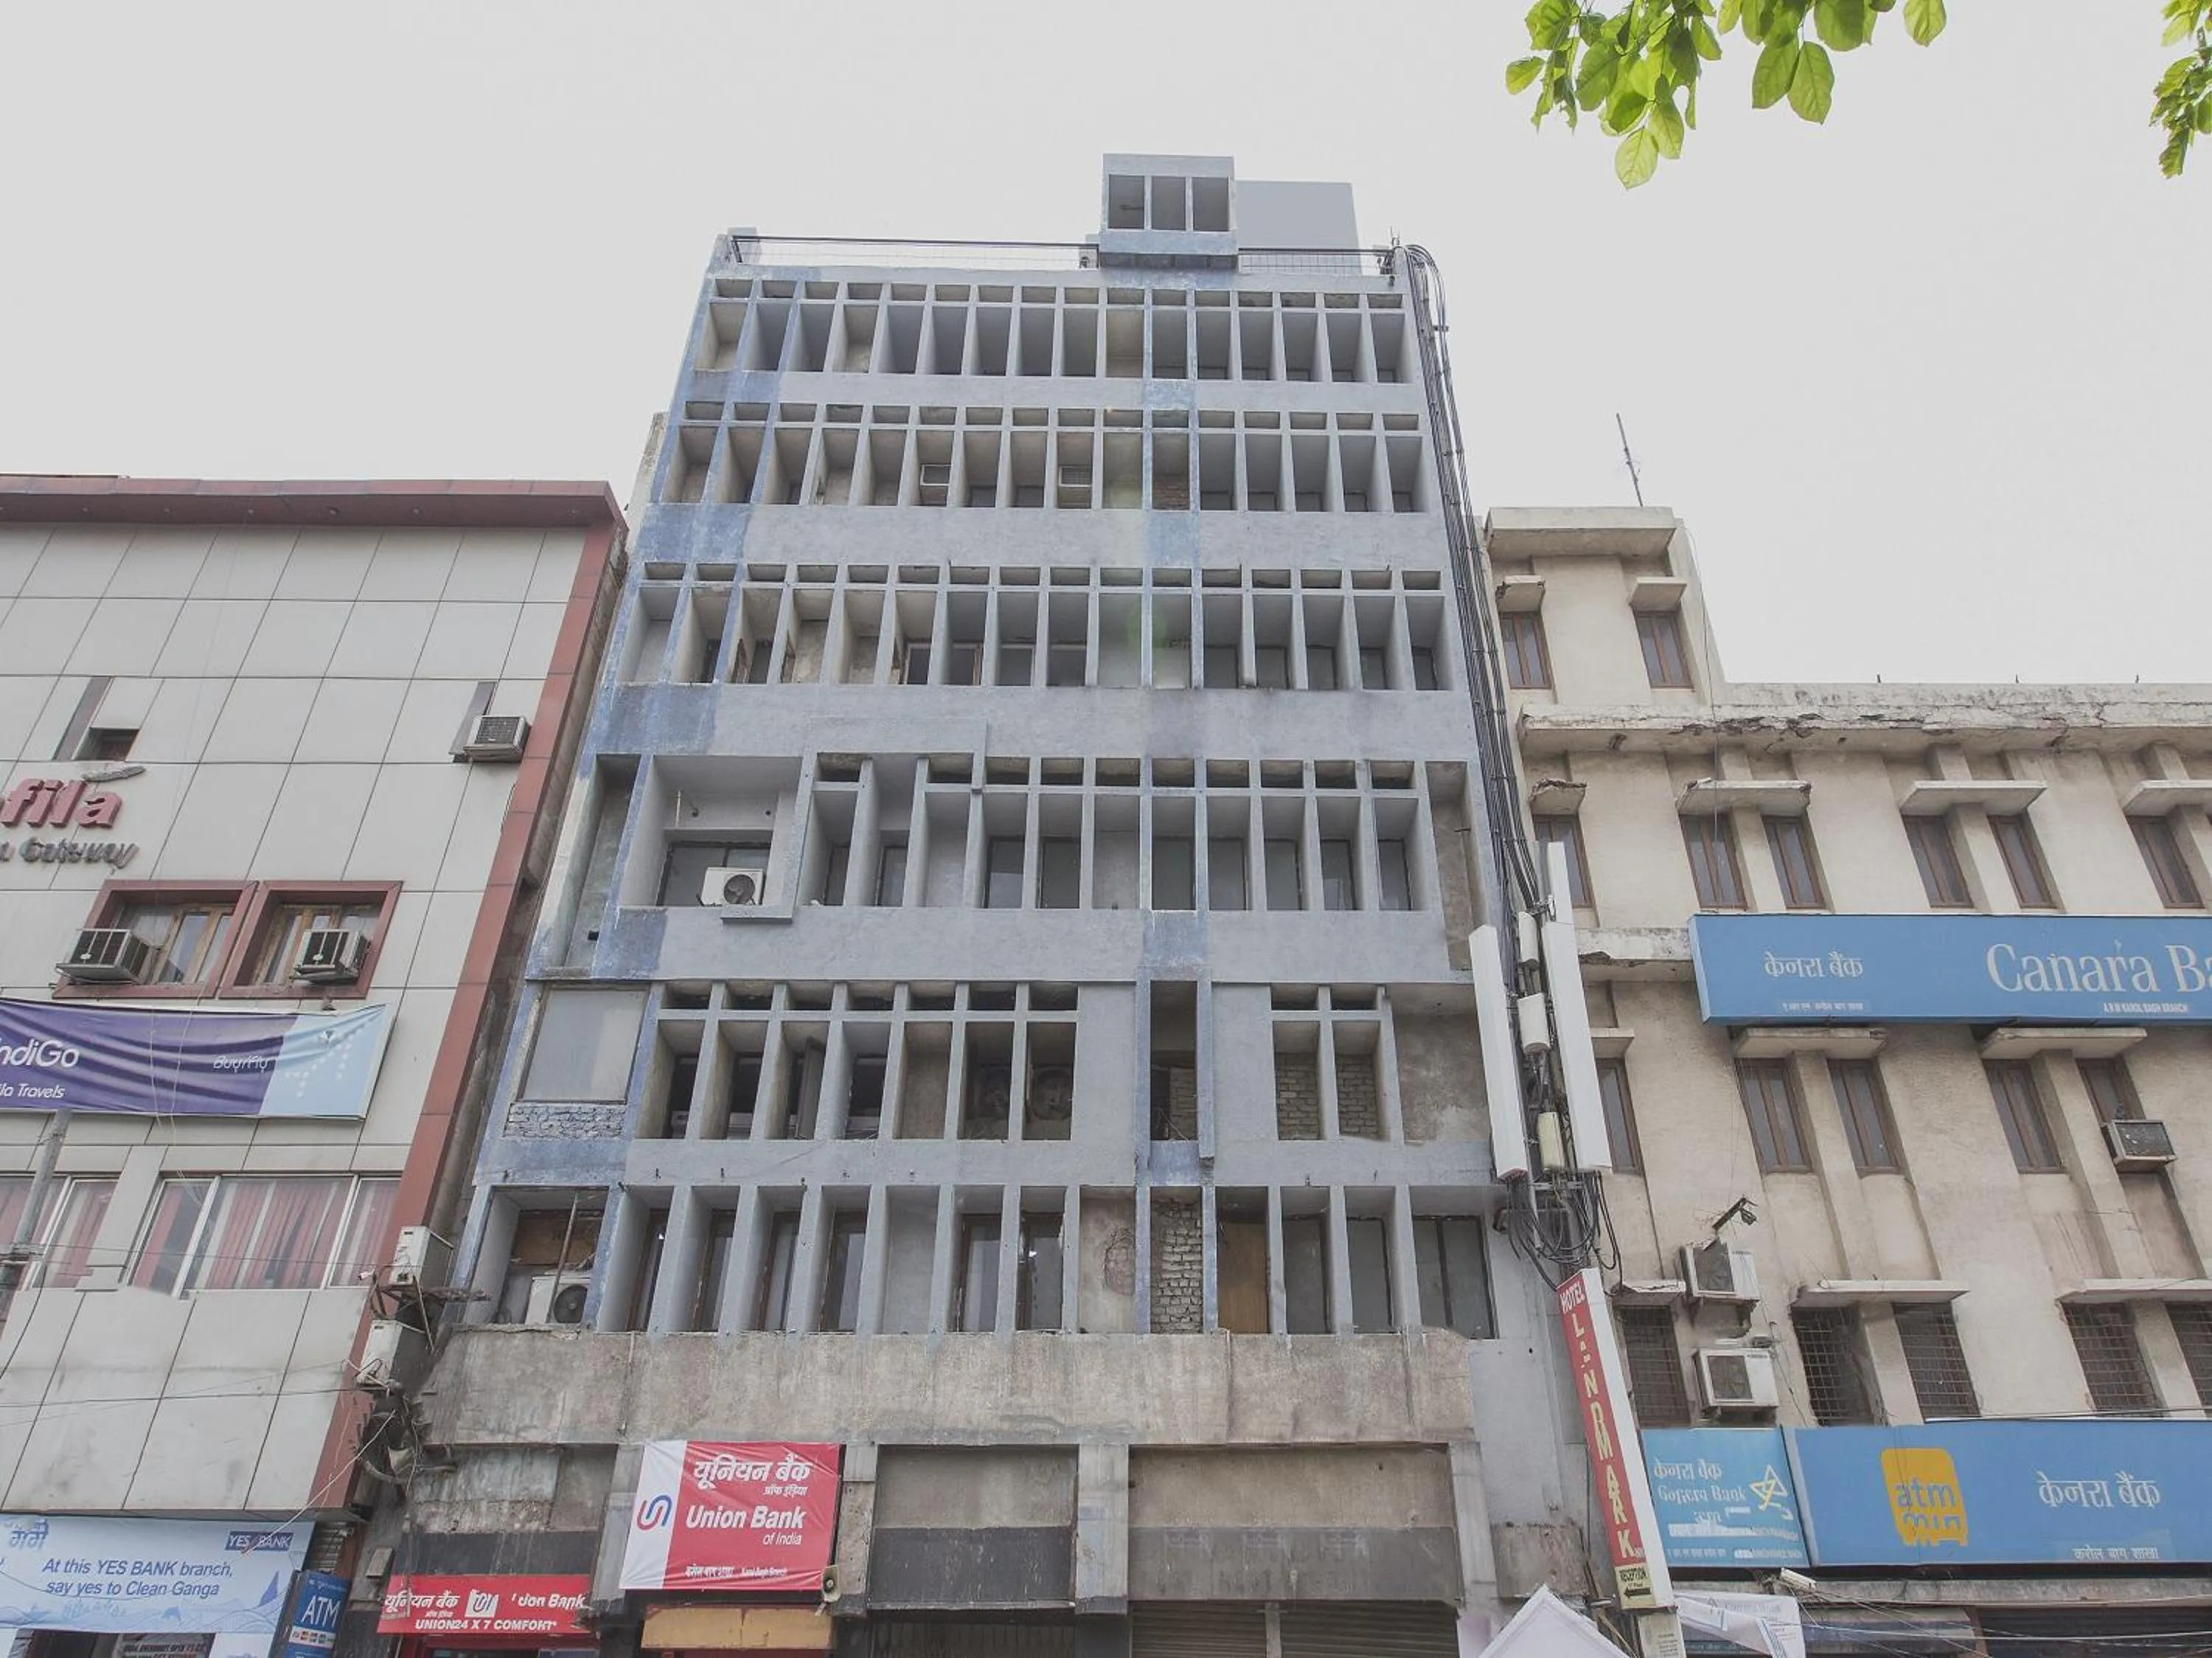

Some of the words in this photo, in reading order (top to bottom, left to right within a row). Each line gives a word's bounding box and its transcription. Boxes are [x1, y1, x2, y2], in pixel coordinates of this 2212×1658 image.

[0, 778, 122, 828] fila
[1764, 950, 1825, 978] केनरा
[1828, 949, 1863, 978] बैंक
[1987, 943, 2162, 993] Canara
[0, 1038, 79, 1067] ndiGo
[18, 1083, 65, 1098] Travels
[694, 1454, 773, 1490] यूनियन
[775, 1453, 814, 1482] बैंक
[1894, 1477, 1956, 1508] atm
[2037, 1471, 2115, 1508] केनरा
[2115, 1470, 2160, 1508] बैंक
[686, 1505, 745, 1529] Union
[751, 1505, 807, 1529] Bank
[229, 1535, 251, 1547] YES
[258, 1535, 291, 1547] BANK
[762, 1533, 776, 1547] of
[776, 1532, 802, 1546] India
[42, 1558, 61, 1573] At
[63, 1558, 91, 1574] this
[97, 1560, 128, 1575] YES
[131, 1560, 178, 1576] BANK
[46, 1581, 74, 1597] say
[77, 1581, 102, 1597] yes
[107, 1581, 122, 1595] to
[126, 1581, 167, 1596] Clean
[172, 1581, 220, 1599] Ganga
[300, 1595, 341, 1628] ATM
[471, 1619, 481, 1629] X
[483, 1619, 490, 1629] 7
